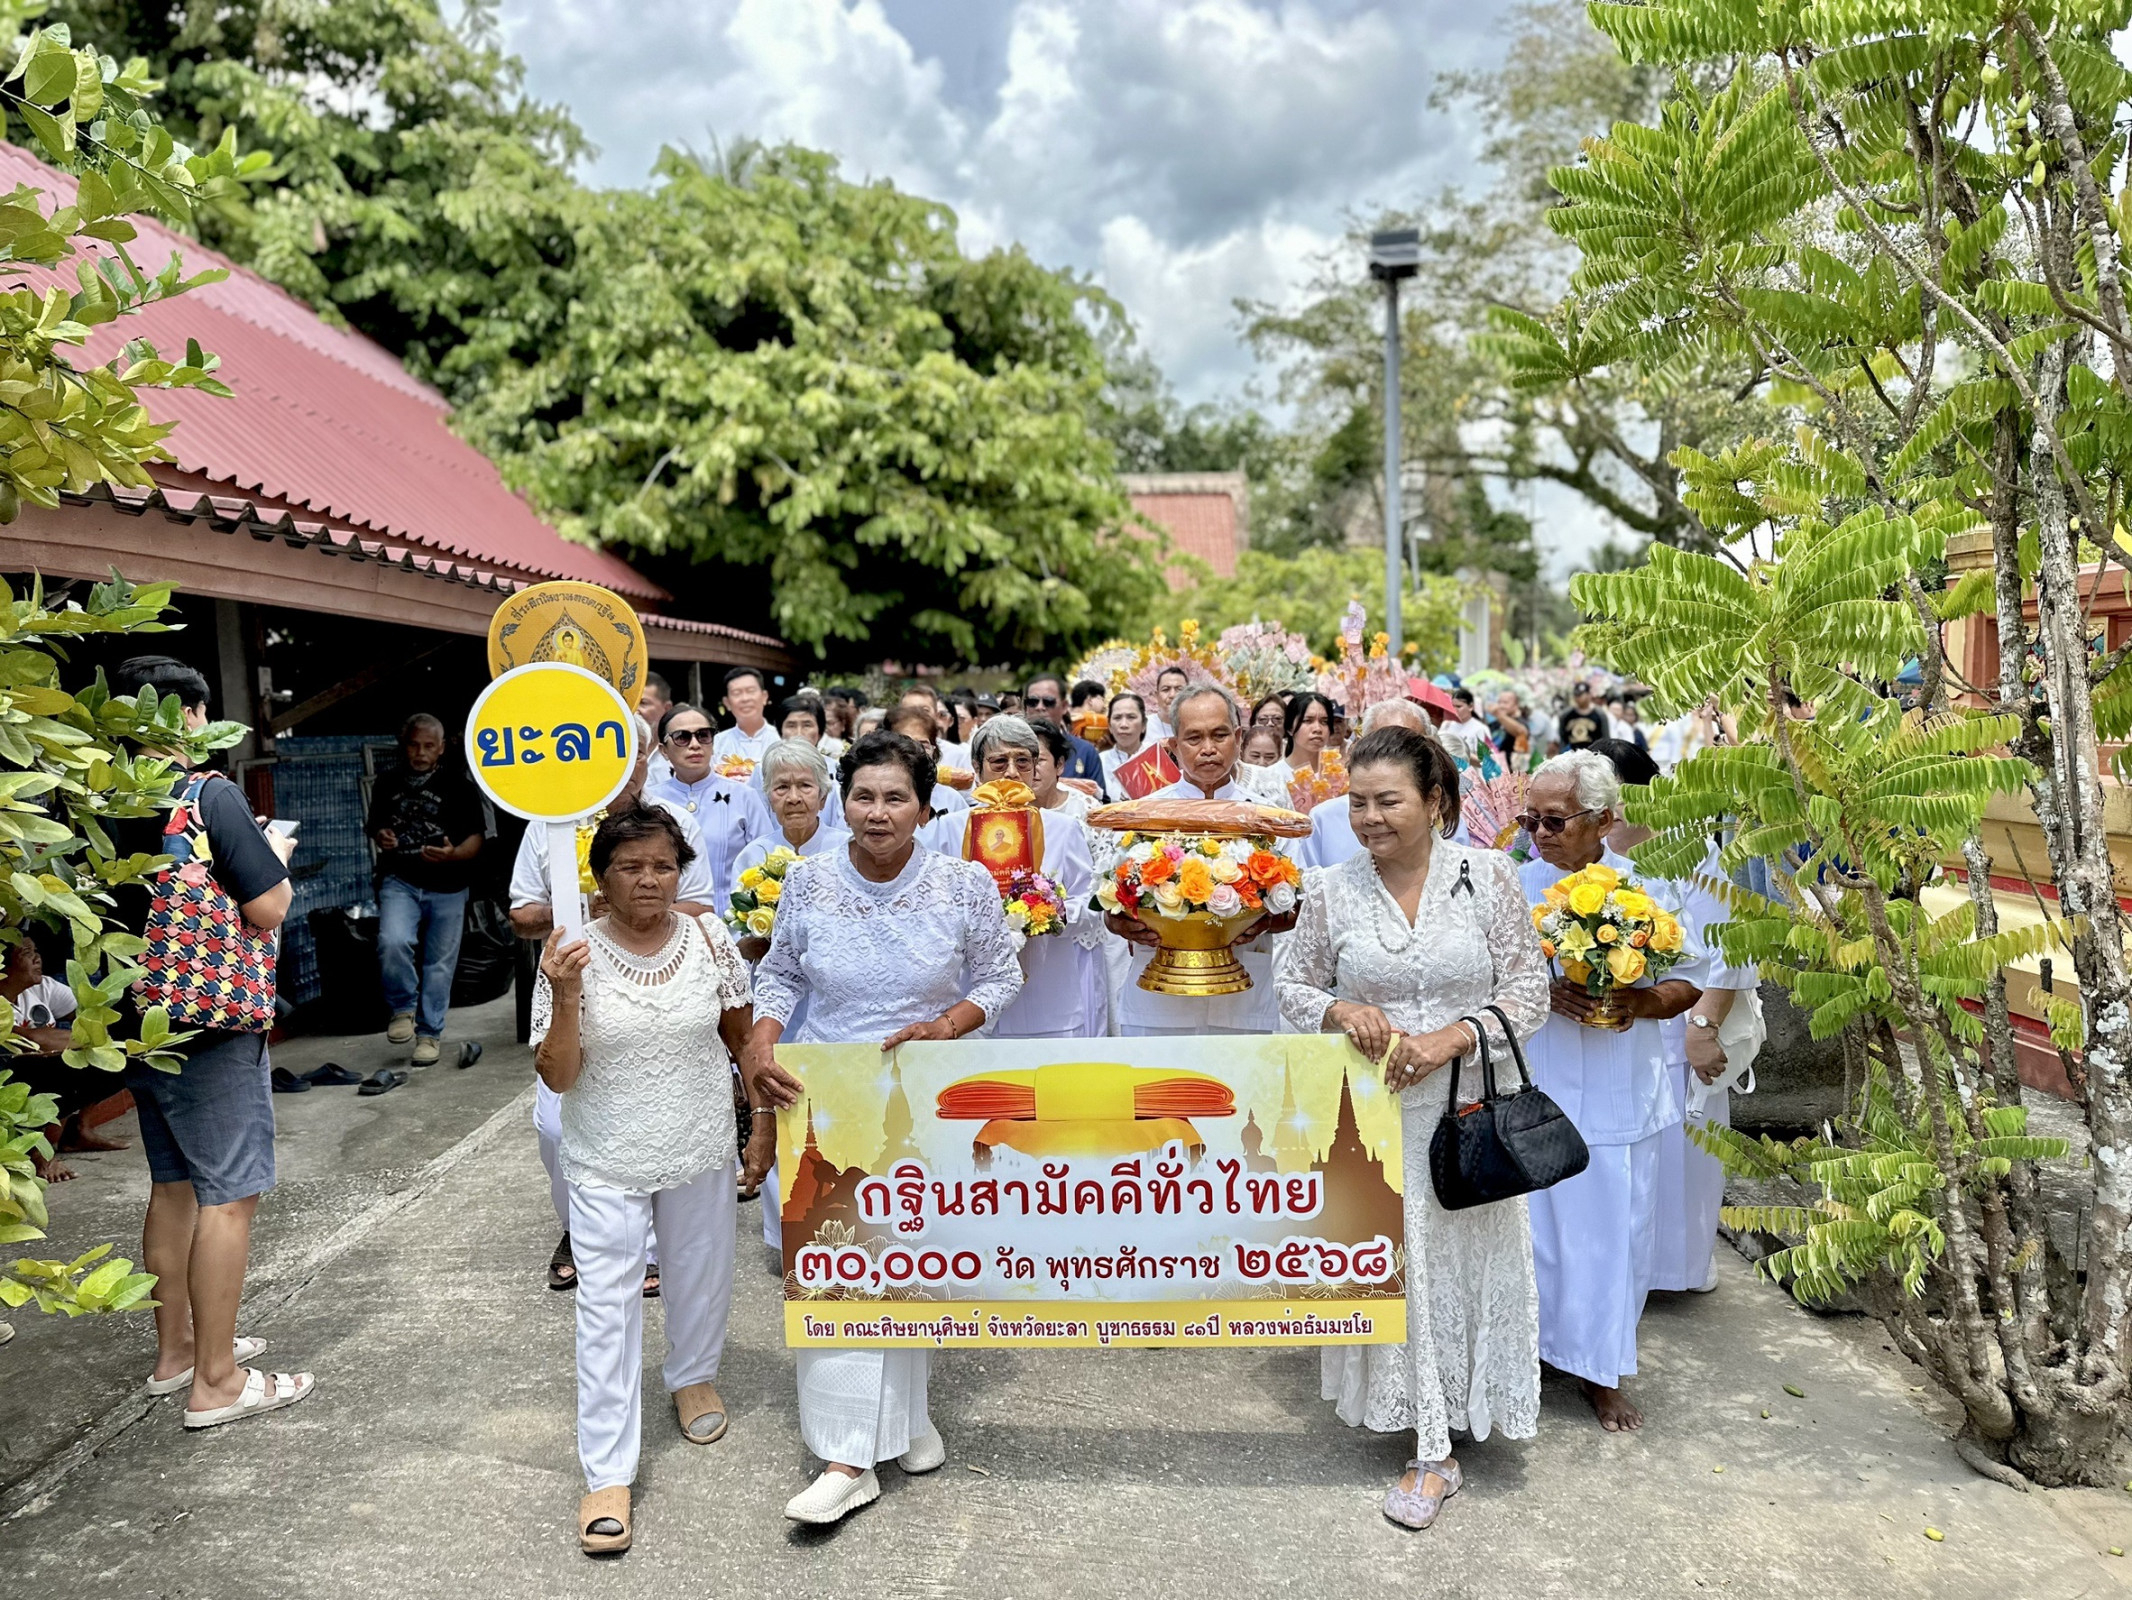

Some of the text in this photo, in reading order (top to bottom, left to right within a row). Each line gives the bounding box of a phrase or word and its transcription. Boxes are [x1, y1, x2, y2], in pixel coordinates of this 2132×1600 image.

[477, 721, 627, 767] ยะลา
[861, 1146, 1317, 1232] กฐินสามัคคีทั่วไทย
[801, 1242, 1387, 1291] ๓๐,๐๐๐ วัด พุทธศักราช ๒๕๖๘
[804, 1316, 835, 1337] โดย
[843, 1311, 979, 1343] คณะศิษยานุศิษย์
[987, 1317, 1087, 1337] จังหวัดยะลา
[1097, 1320, 1175, 1343] บูชาธรรม
[1229, 1309, 1372, 1335] หลวงพ่อธัมมชโย
